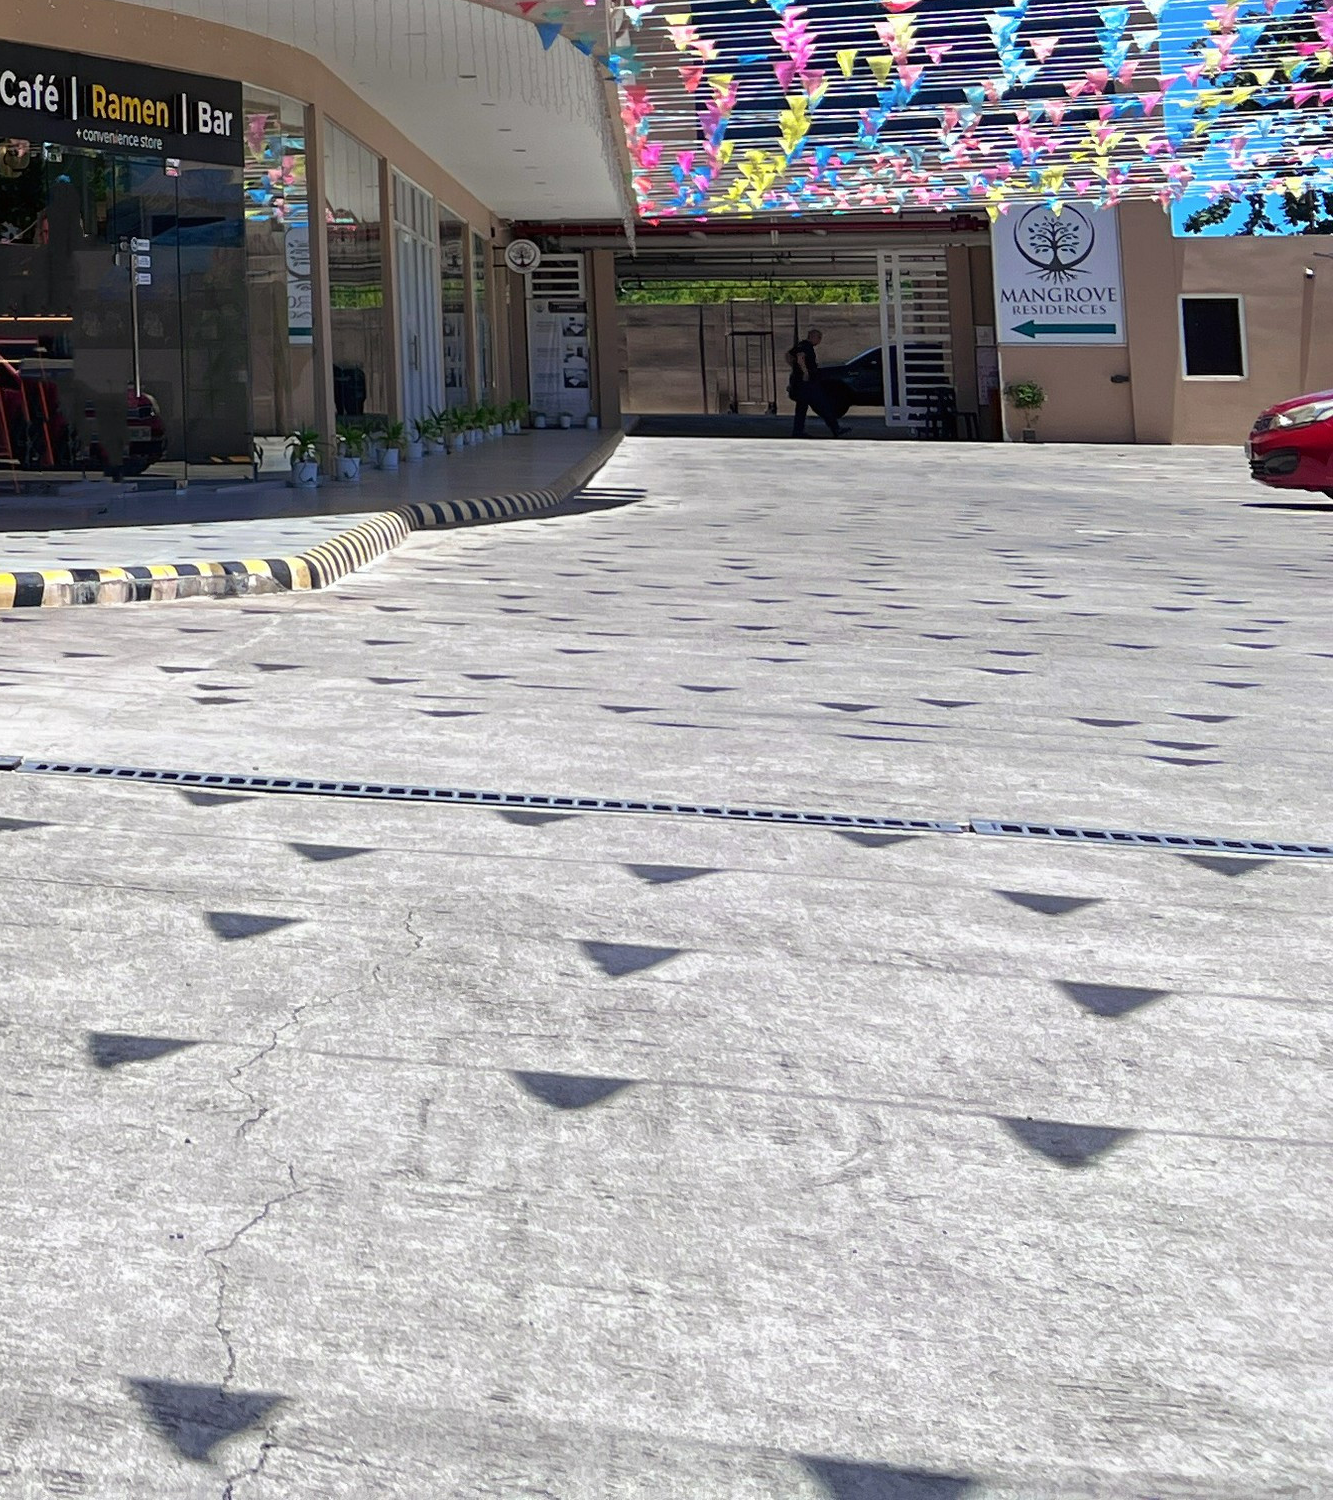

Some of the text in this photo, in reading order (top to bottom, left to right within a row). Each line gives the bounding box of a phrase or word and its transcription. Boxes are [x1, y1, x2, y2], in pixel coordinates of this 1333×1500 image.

[0, 70, 59, 113] Café
[91, 83, 169, 128] Ramen
[197, 101, 233, 137] Bar
[83, 129, 139, 148] convenience
[140, 134, 163, 151] store
[1000, 287, 1117, 303] MANGROVE
[1013, 304, 1107, 316] RESIDENCES
